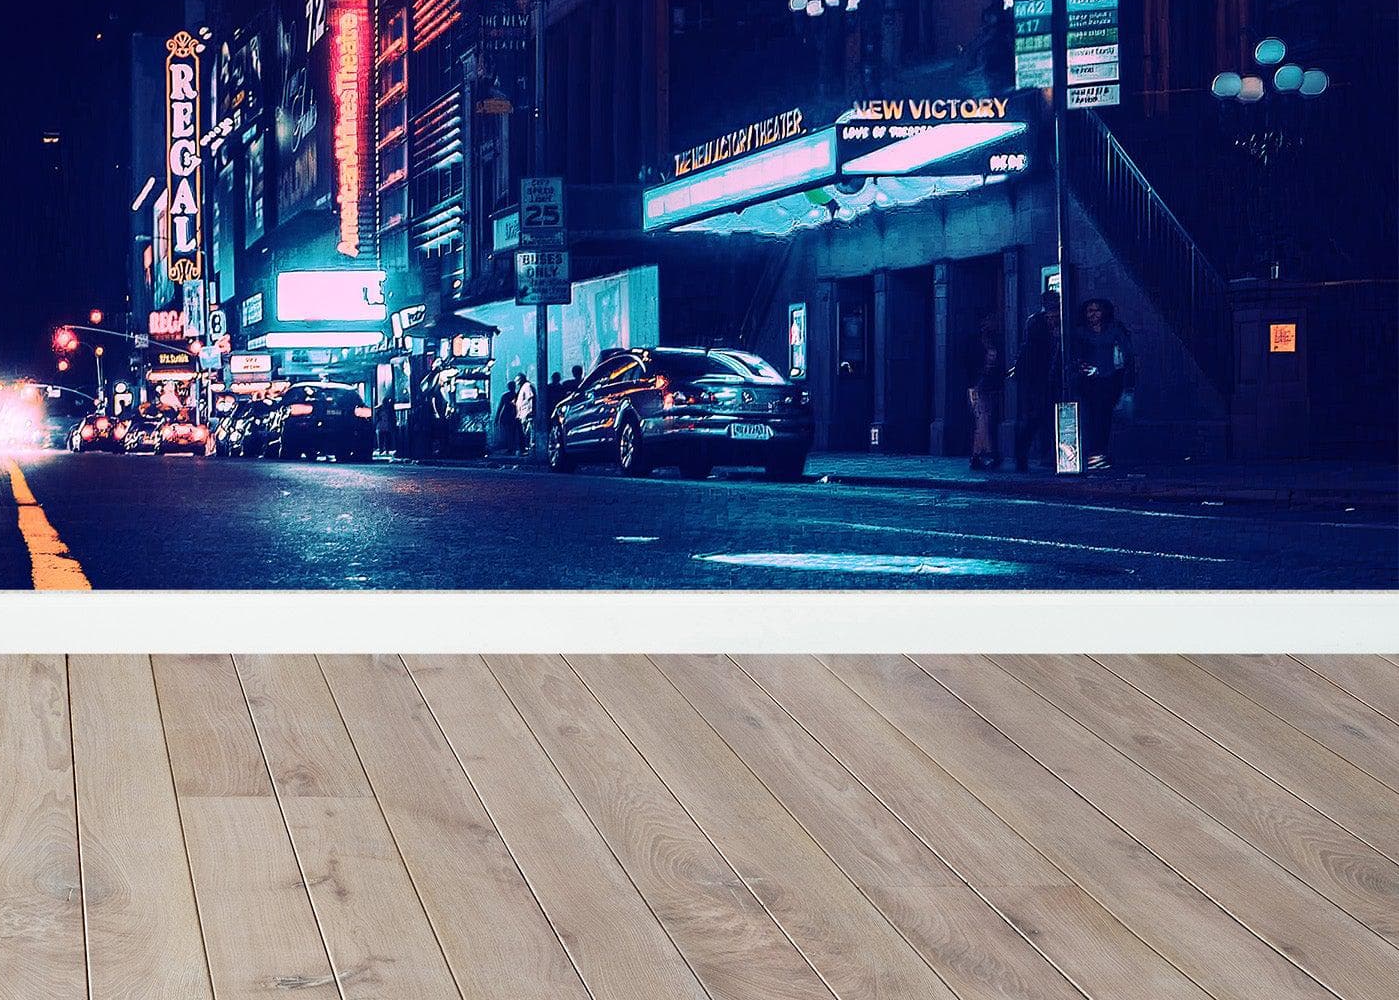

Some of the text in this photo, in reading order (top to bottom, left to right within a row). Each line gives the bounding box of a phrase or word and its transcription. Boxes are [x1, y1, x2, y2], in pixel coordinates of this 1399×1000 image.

[854, 98, 1009, 120] NEW VICTORY
[753, 107, 803, 149] THEATER
[170, 63, 202, 253] REGAL
[525, 205, 560, 226] 25
[521, 253, 563, 265] BUSES
[526, 266, 559, 278] ONLY
